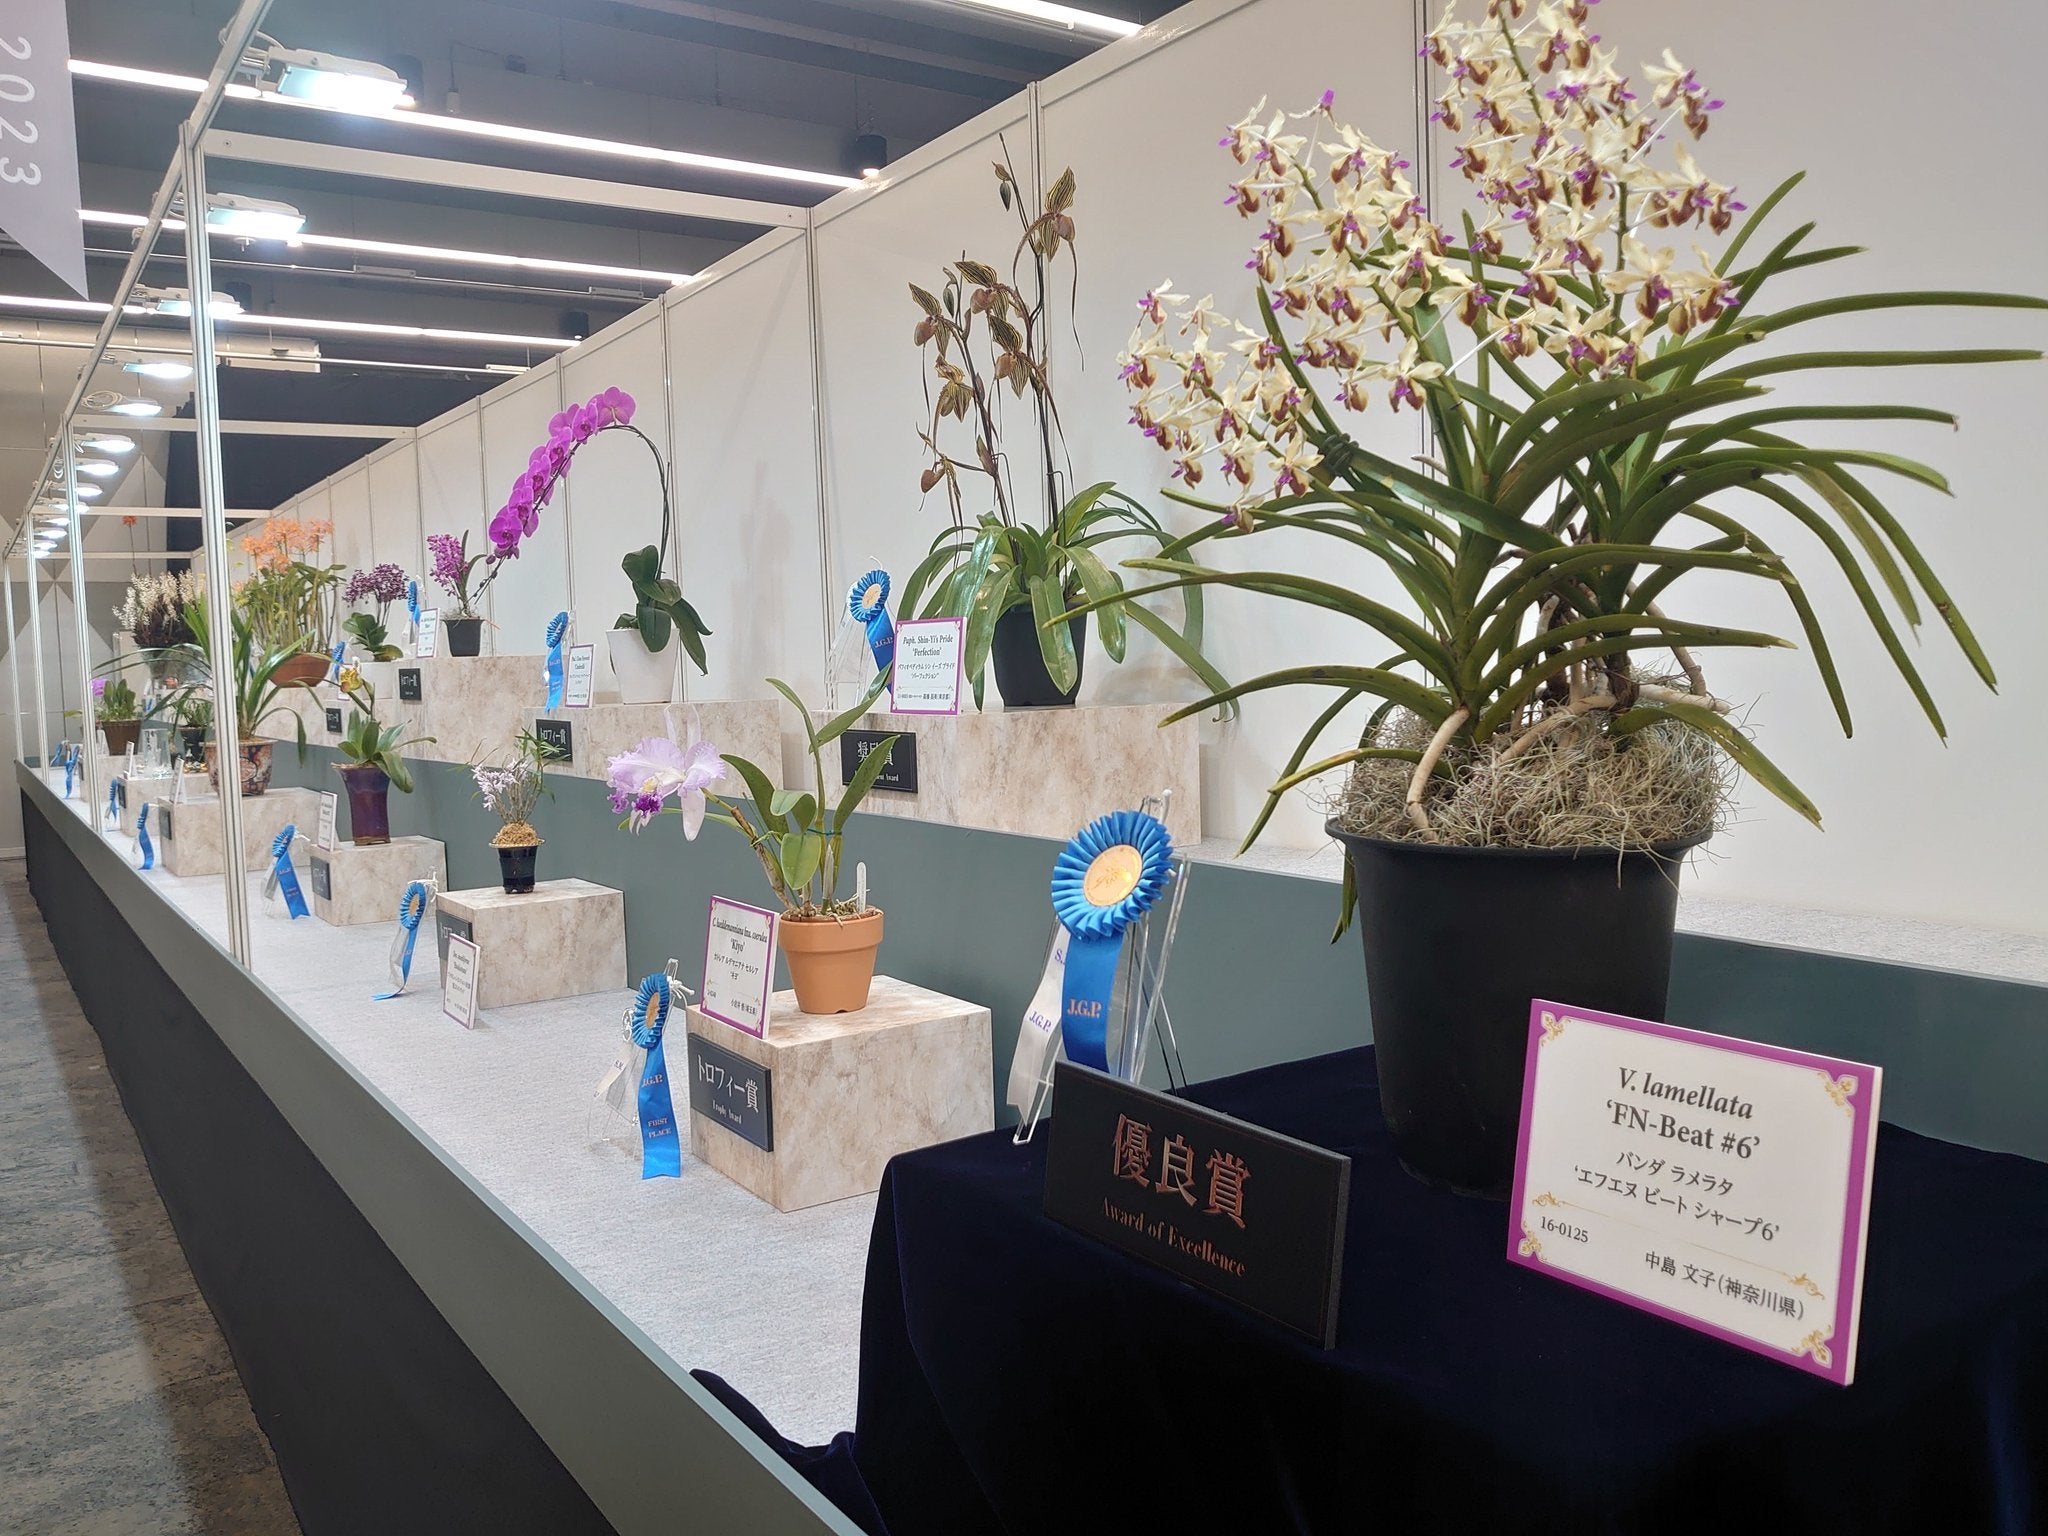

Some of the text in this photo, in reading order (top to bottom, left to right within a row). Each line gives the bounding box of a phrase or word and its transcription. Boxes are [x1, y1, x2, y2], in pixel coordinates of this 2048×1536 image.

[0, 36, 42, 186] 2023
[1029, 1011, 1052, 1032] J.G.P.
[1066, 998, 1102, 1019] J.G.P.
[698, 1054, 759, 1114] トロフィー賞
[1618, 1066, 1753, 1119] V. lamellata
[1606, 1099, 1760, 1159] ‘FN-Beat #6’
[1112, 1113, 1251, 1229] 優良賞
[1616, 1151, 1734, 1196] バンダ ラメラタ
[1540, 1216, 1589, 1243] 16-0125
[1574, 1165, 1780, 1241] ‘エフエヌ ビート シャープ6’
[1103, 1197, 1246, 1278] Award of Excellence
[1645, 1251, 1676, 1277] 中島
